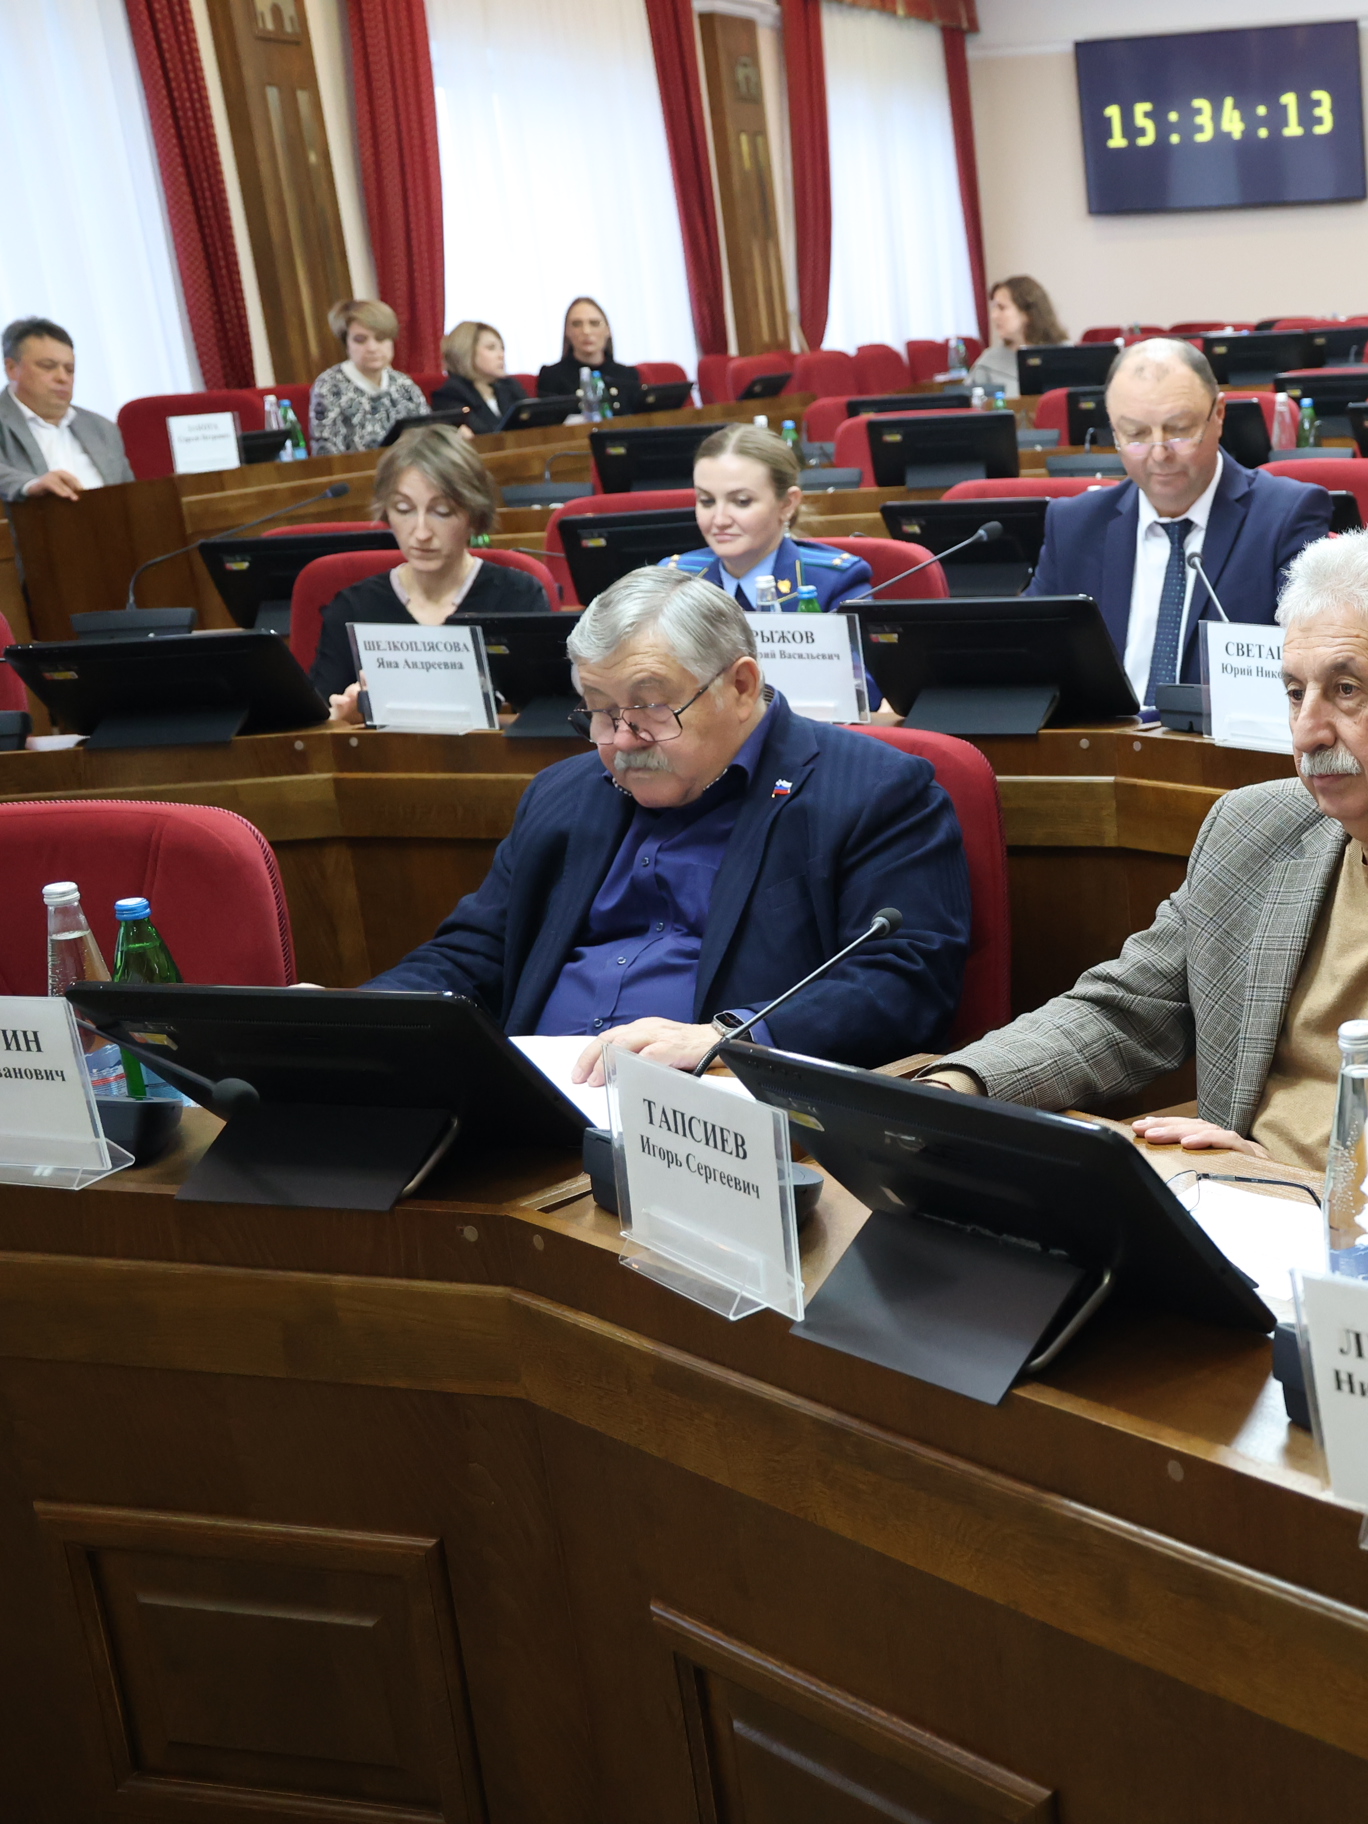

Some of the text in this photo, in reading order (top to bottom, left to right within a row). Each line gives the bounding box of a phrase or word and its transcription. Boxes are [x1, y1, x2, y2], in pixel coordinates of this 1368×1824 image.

[1103, 89, 1334, 149] 15:34:13
[376, 657, 465, 673] Яна Андреевна
[779, 650, 840, 661] Васильевич
[1221, 662, 1283, 680] Юрий Нико
[0, 1029, 44, 1053] ИН
[642, 1097, 748, 1161] ТАПСИЕВ
[639, 1133, 761, 1200] Игорь Сергеевич
